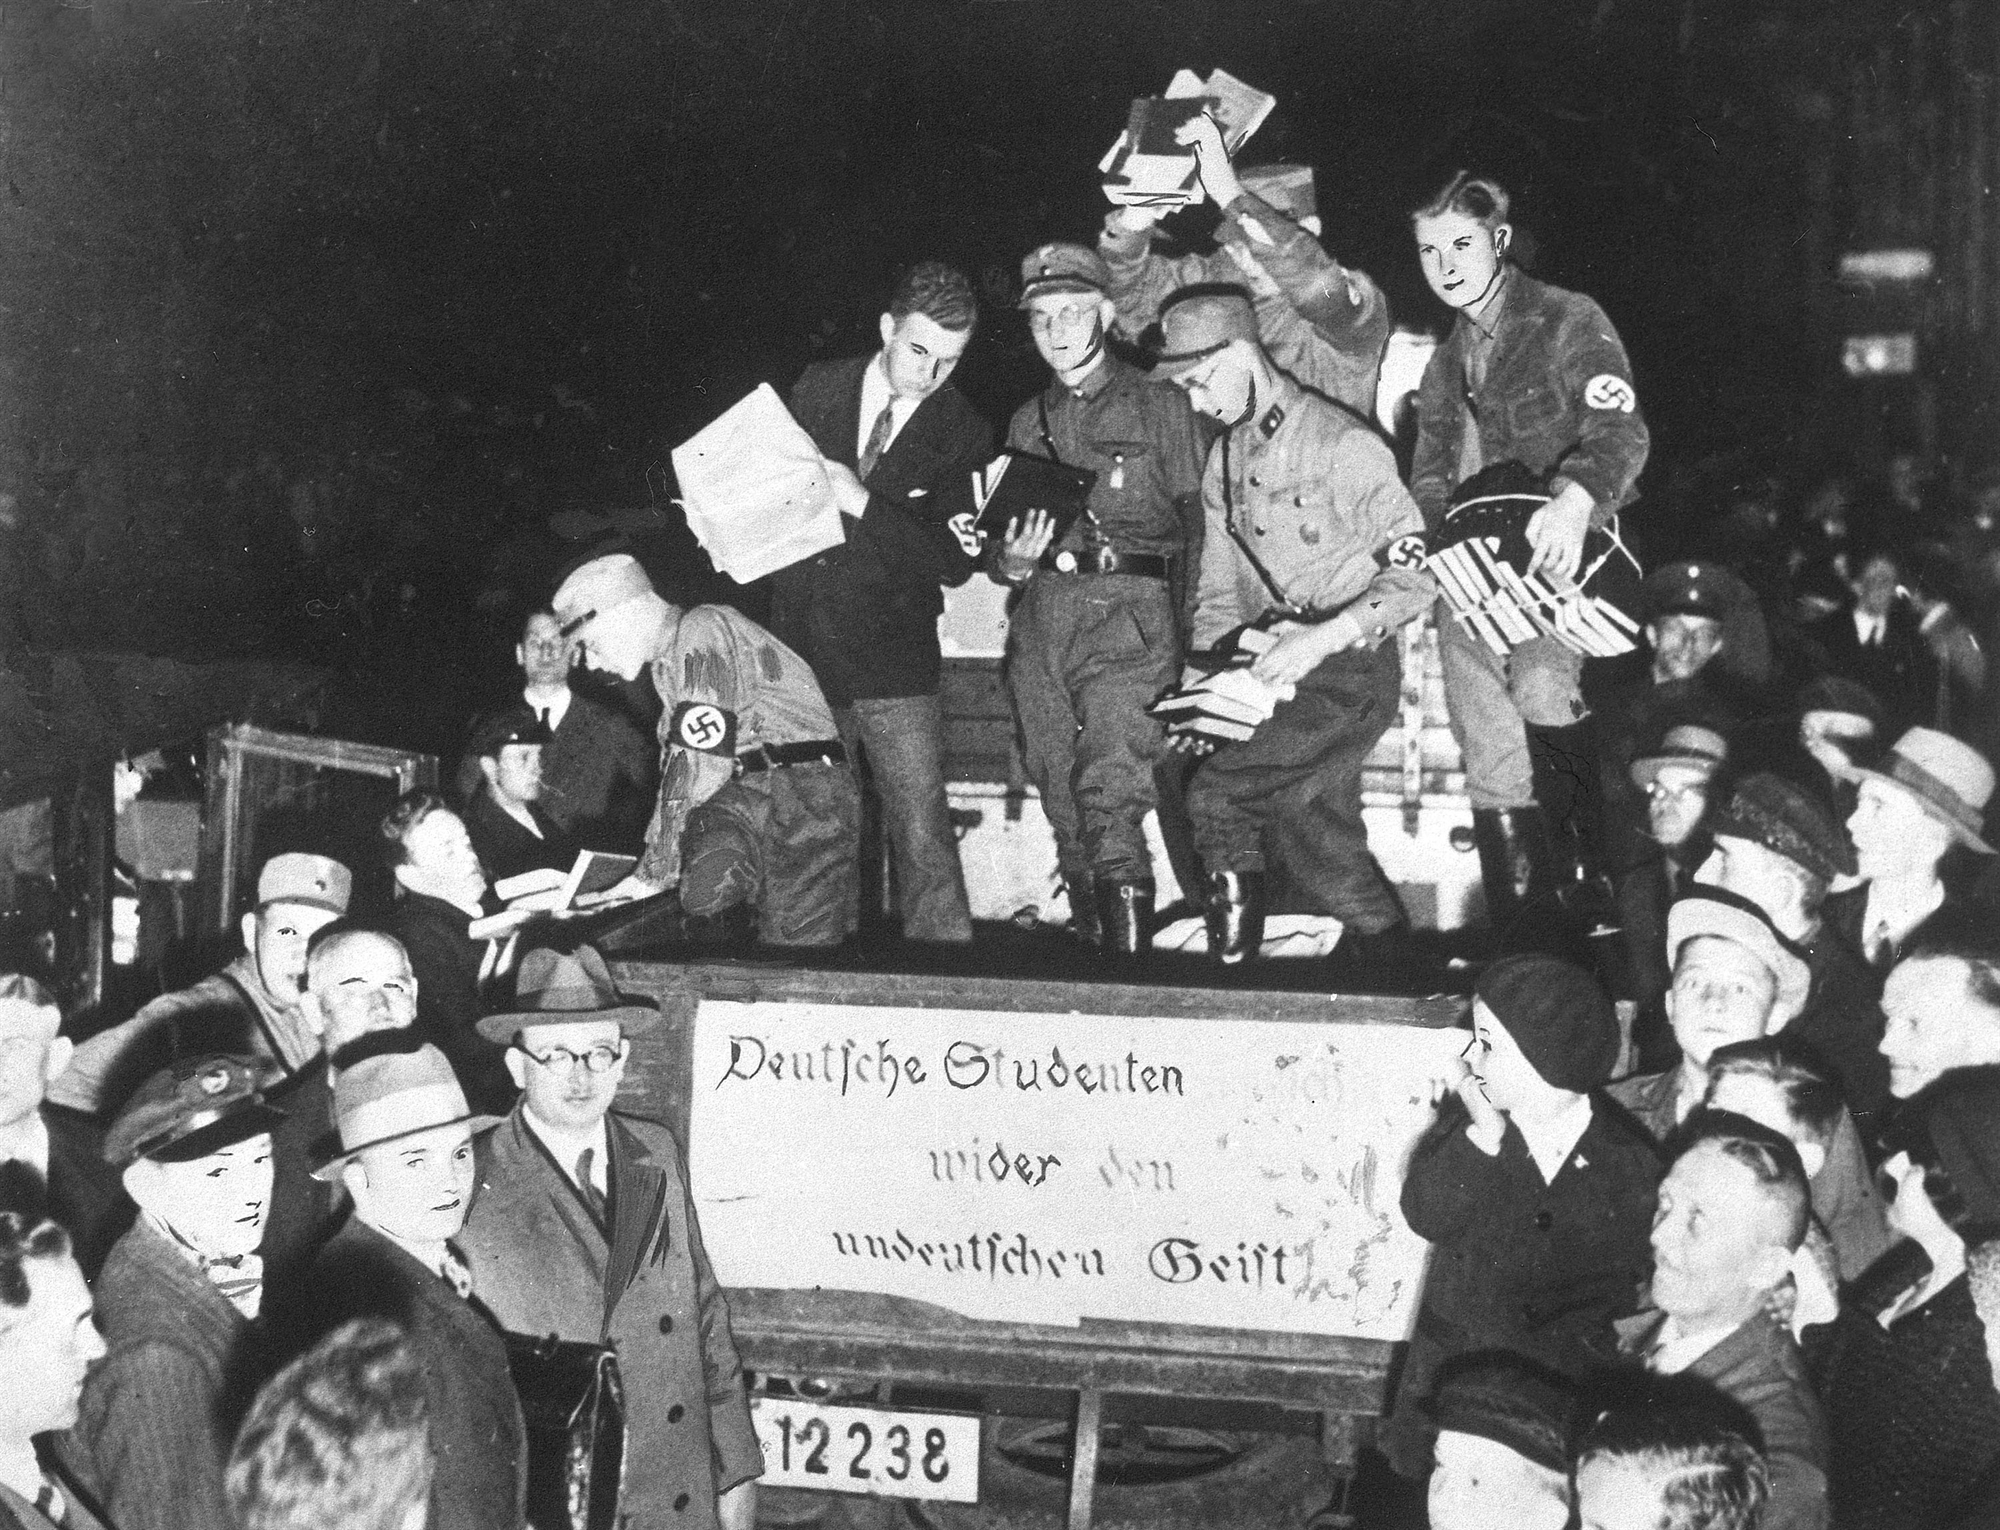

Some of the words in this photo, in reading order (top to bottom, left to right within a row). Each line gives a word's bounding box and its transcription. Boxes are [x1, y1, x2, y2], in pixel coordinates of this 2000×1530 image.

[944, 1040, 1184, 1097] Studenten
[929, 1136, 1063, 1187] wider
[1099, 1146, 1176, 1191] den
[1148, 1236, 1288, 1290] Geist
[772, 1415, 950, 1484] 12238
